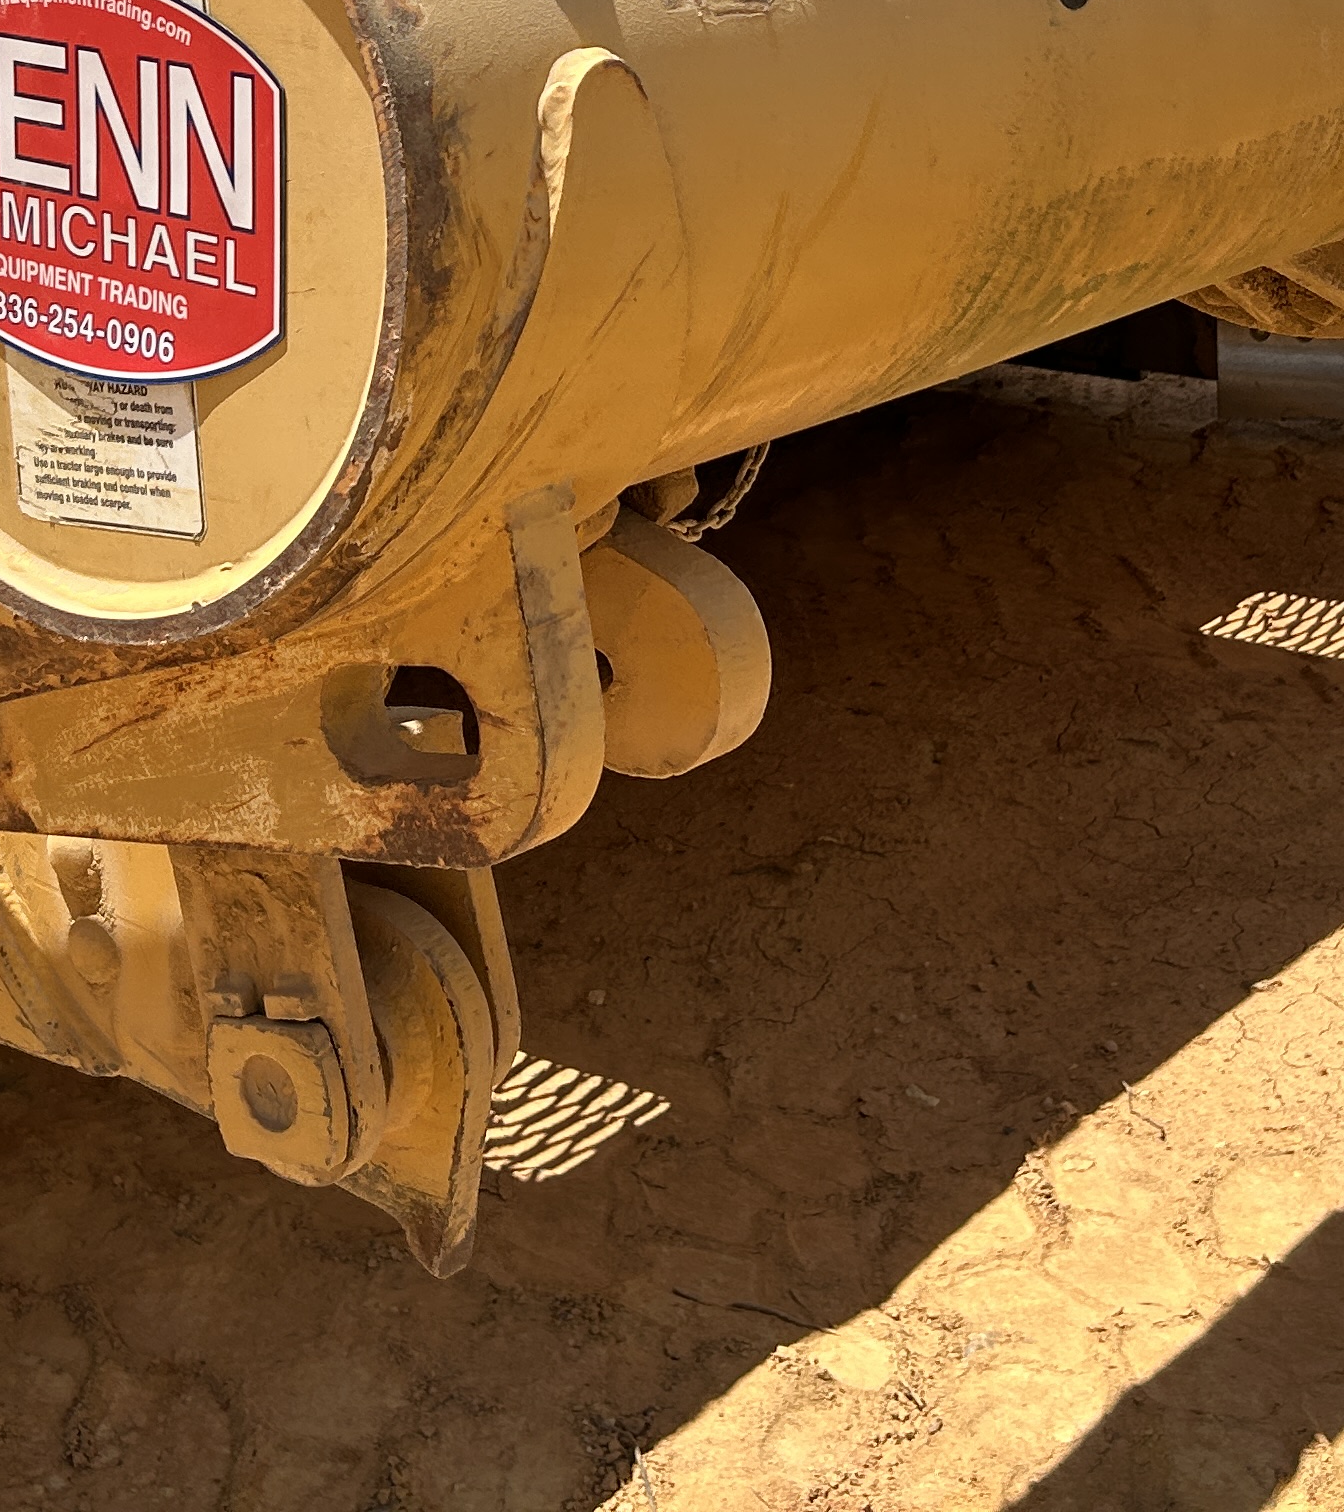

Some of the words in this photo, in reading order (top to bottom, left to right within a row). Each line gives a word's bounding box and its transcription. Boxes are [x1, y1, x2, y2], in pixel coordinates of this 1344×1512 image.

[97, 276, 189, 320] TRADING
[107, 381, 148, 397] HAZARD
[130, 400, 153, 413] death
[154, 402, 174, 415] from
[83, 414, 113, 429] moving
[126, 434, 142, 445] and
[143, 434, 154, 446] be
[155, 438, 174, 448] sure
[33, 455, 49, 468] Use
[50, 459, 56, 469] a
[56, 459, 83, 472] tractor
[84, 460, 104, 476] large
[105, 465, 135, 480] enough
[137, 468, 145, 478] to
[146, 469, 177, 483] provide
[34, 473, 71, 487] sufficient
[72, 476, 102, 493] braking
[119, 483, 148, 496] control
[149, 485, 172, 498] when
[36, 489, 65, 504] moving
[72, 492, 99, 506] loaded
